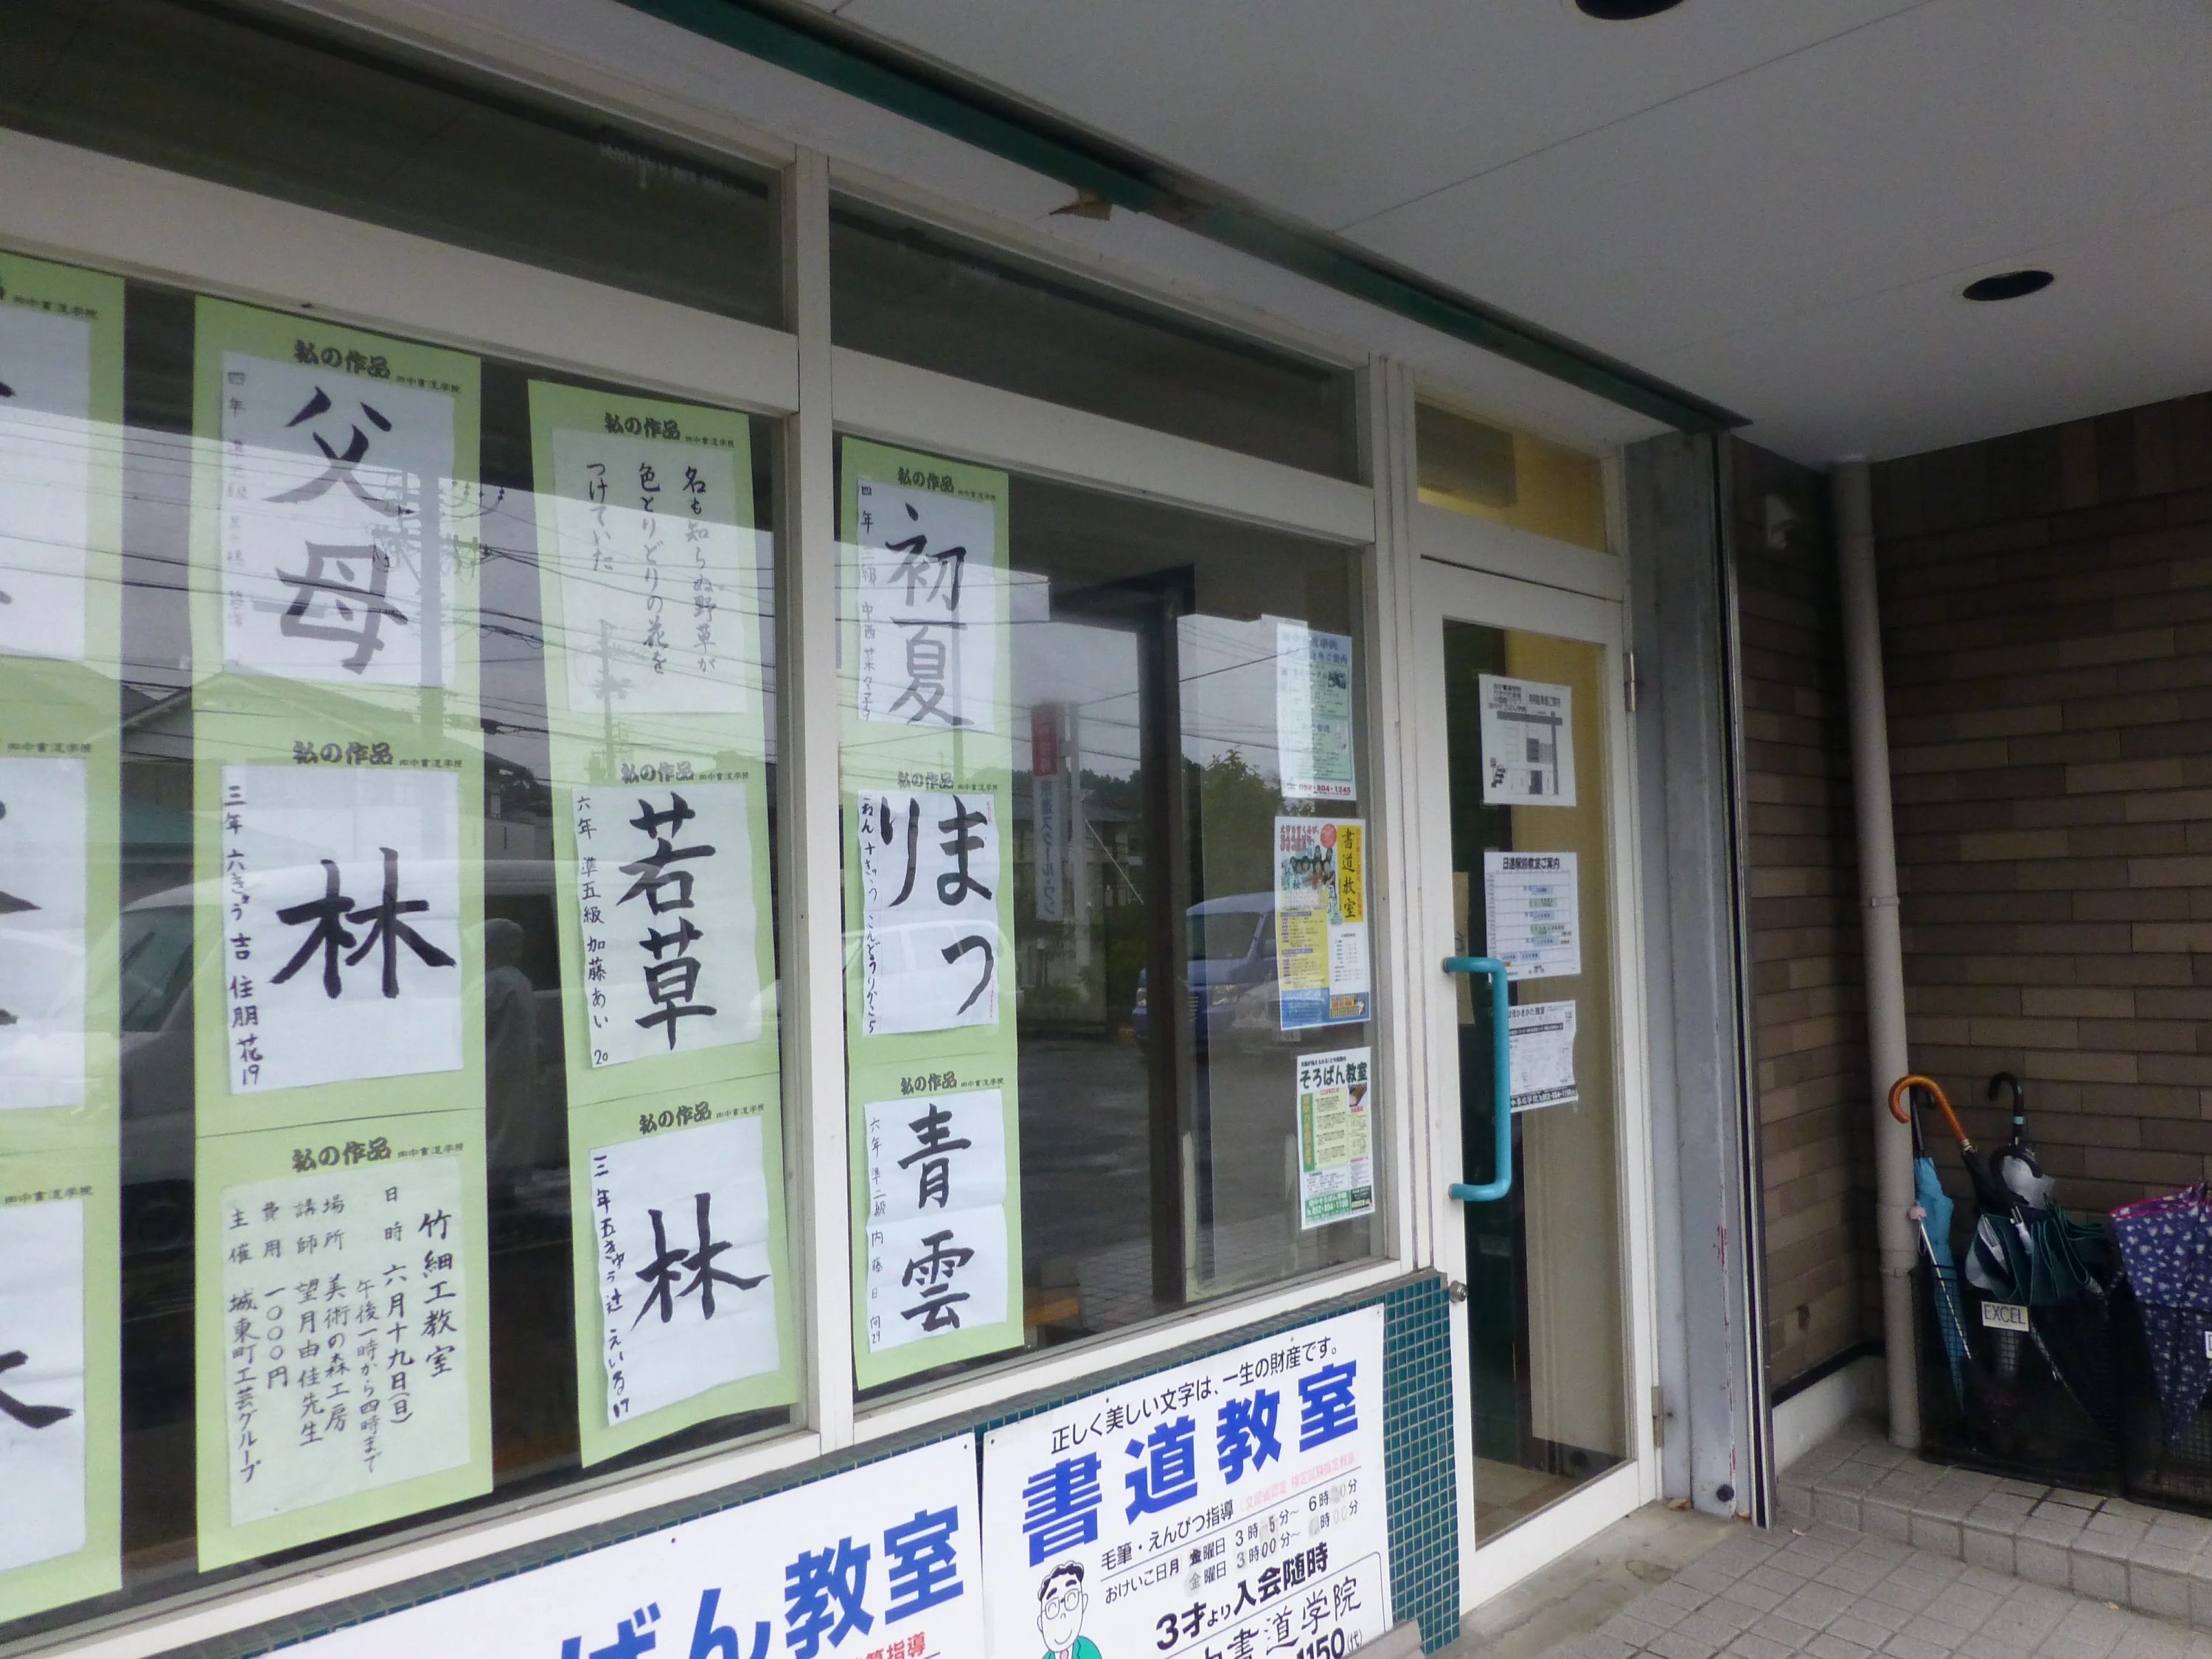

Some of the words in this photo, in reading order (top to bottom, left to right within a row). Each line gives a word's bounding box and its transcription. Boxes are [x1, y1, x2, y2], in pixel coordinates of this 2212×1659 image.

[294, 339, 391, 379] 私の作品
[604, 411, 681, 441] 私の作品
[586, 463, 614, 572] つけていた
[897, 466, 955, 494] 私の作品
[263, 386, 419, 675] 父母
[639, 462, 669, 675] 色とりどりの花を
[885, 502, 974, 726] 初夏
[293, 741, 393, 765] 私の作品
[621, 761, 695, 785] 私の作品
[897, 771, 954, 790] 私の作品
[1342, 827, 1357, 919] 書道教室
[269, 846, 456, 999] 林
[616, 791, 718, 1051] 若草
[639, 1101, 712, 1134] 私の作品
[900, 1071, 958, 1096] 私の作品
[1299, 1061, 1368, 1090] そろばん教室
[292, 1136, 392, 1172] 私の作品
[629, 1192, 771, 1332] 林
[897, 1103, 975, 1332] 青雲
[417, 1209, 458, 1378] 竹細工教室
[1984, 1304, 2026, 1325] EXCEL
[1051, 1336, 1340, 1455] 正しく美しい文字は、一生の財産です。
[1022, 1358, 1360, 1568] 書道教室
[1100, 1498, 1235, 1571] 毛筆・えんぴつ指導
[1155, 1541, 1329, 1651] 3才より入会随時
